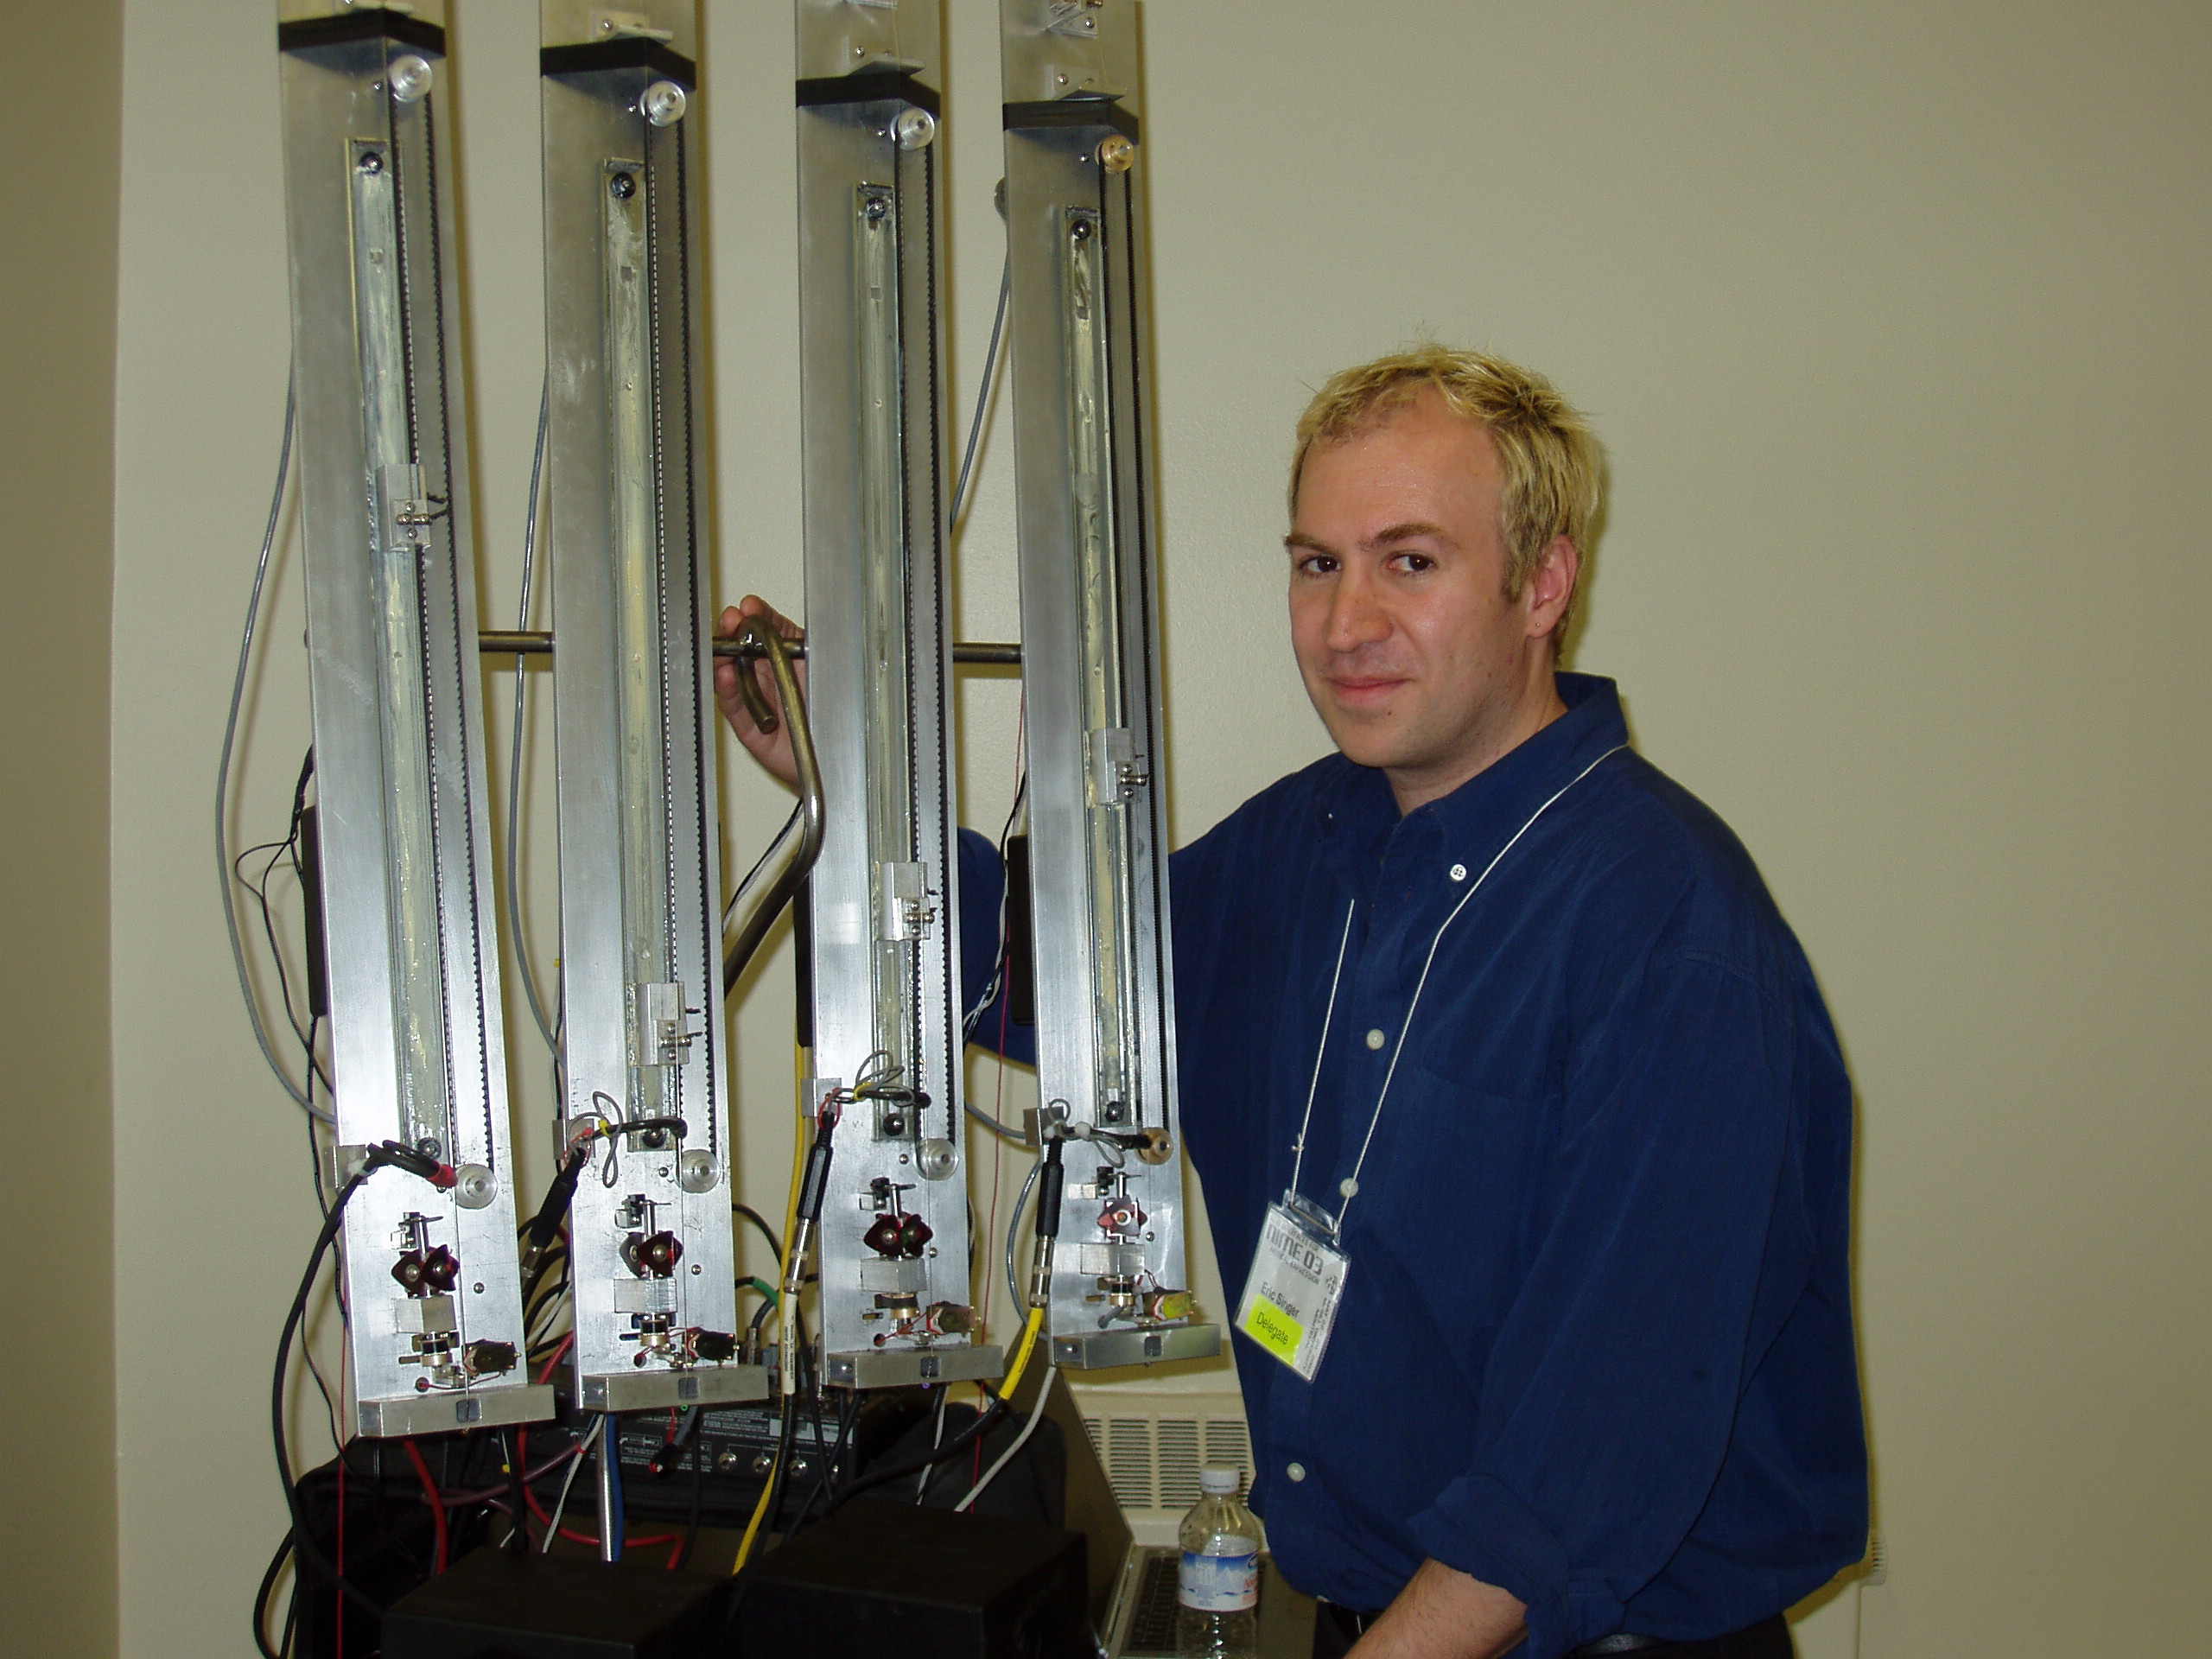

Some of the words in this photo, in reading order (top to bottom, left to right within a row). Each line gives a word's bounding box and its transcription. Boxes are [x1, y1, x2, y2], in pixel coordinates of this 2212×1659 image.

[1303, 1249, 1324, 1276] 03
[1261, 1281, 1276, 1300] Eric
[1276, 1293, 1300, 1319] Singer
[1256, 1312, 1288, 1345] Delegate
